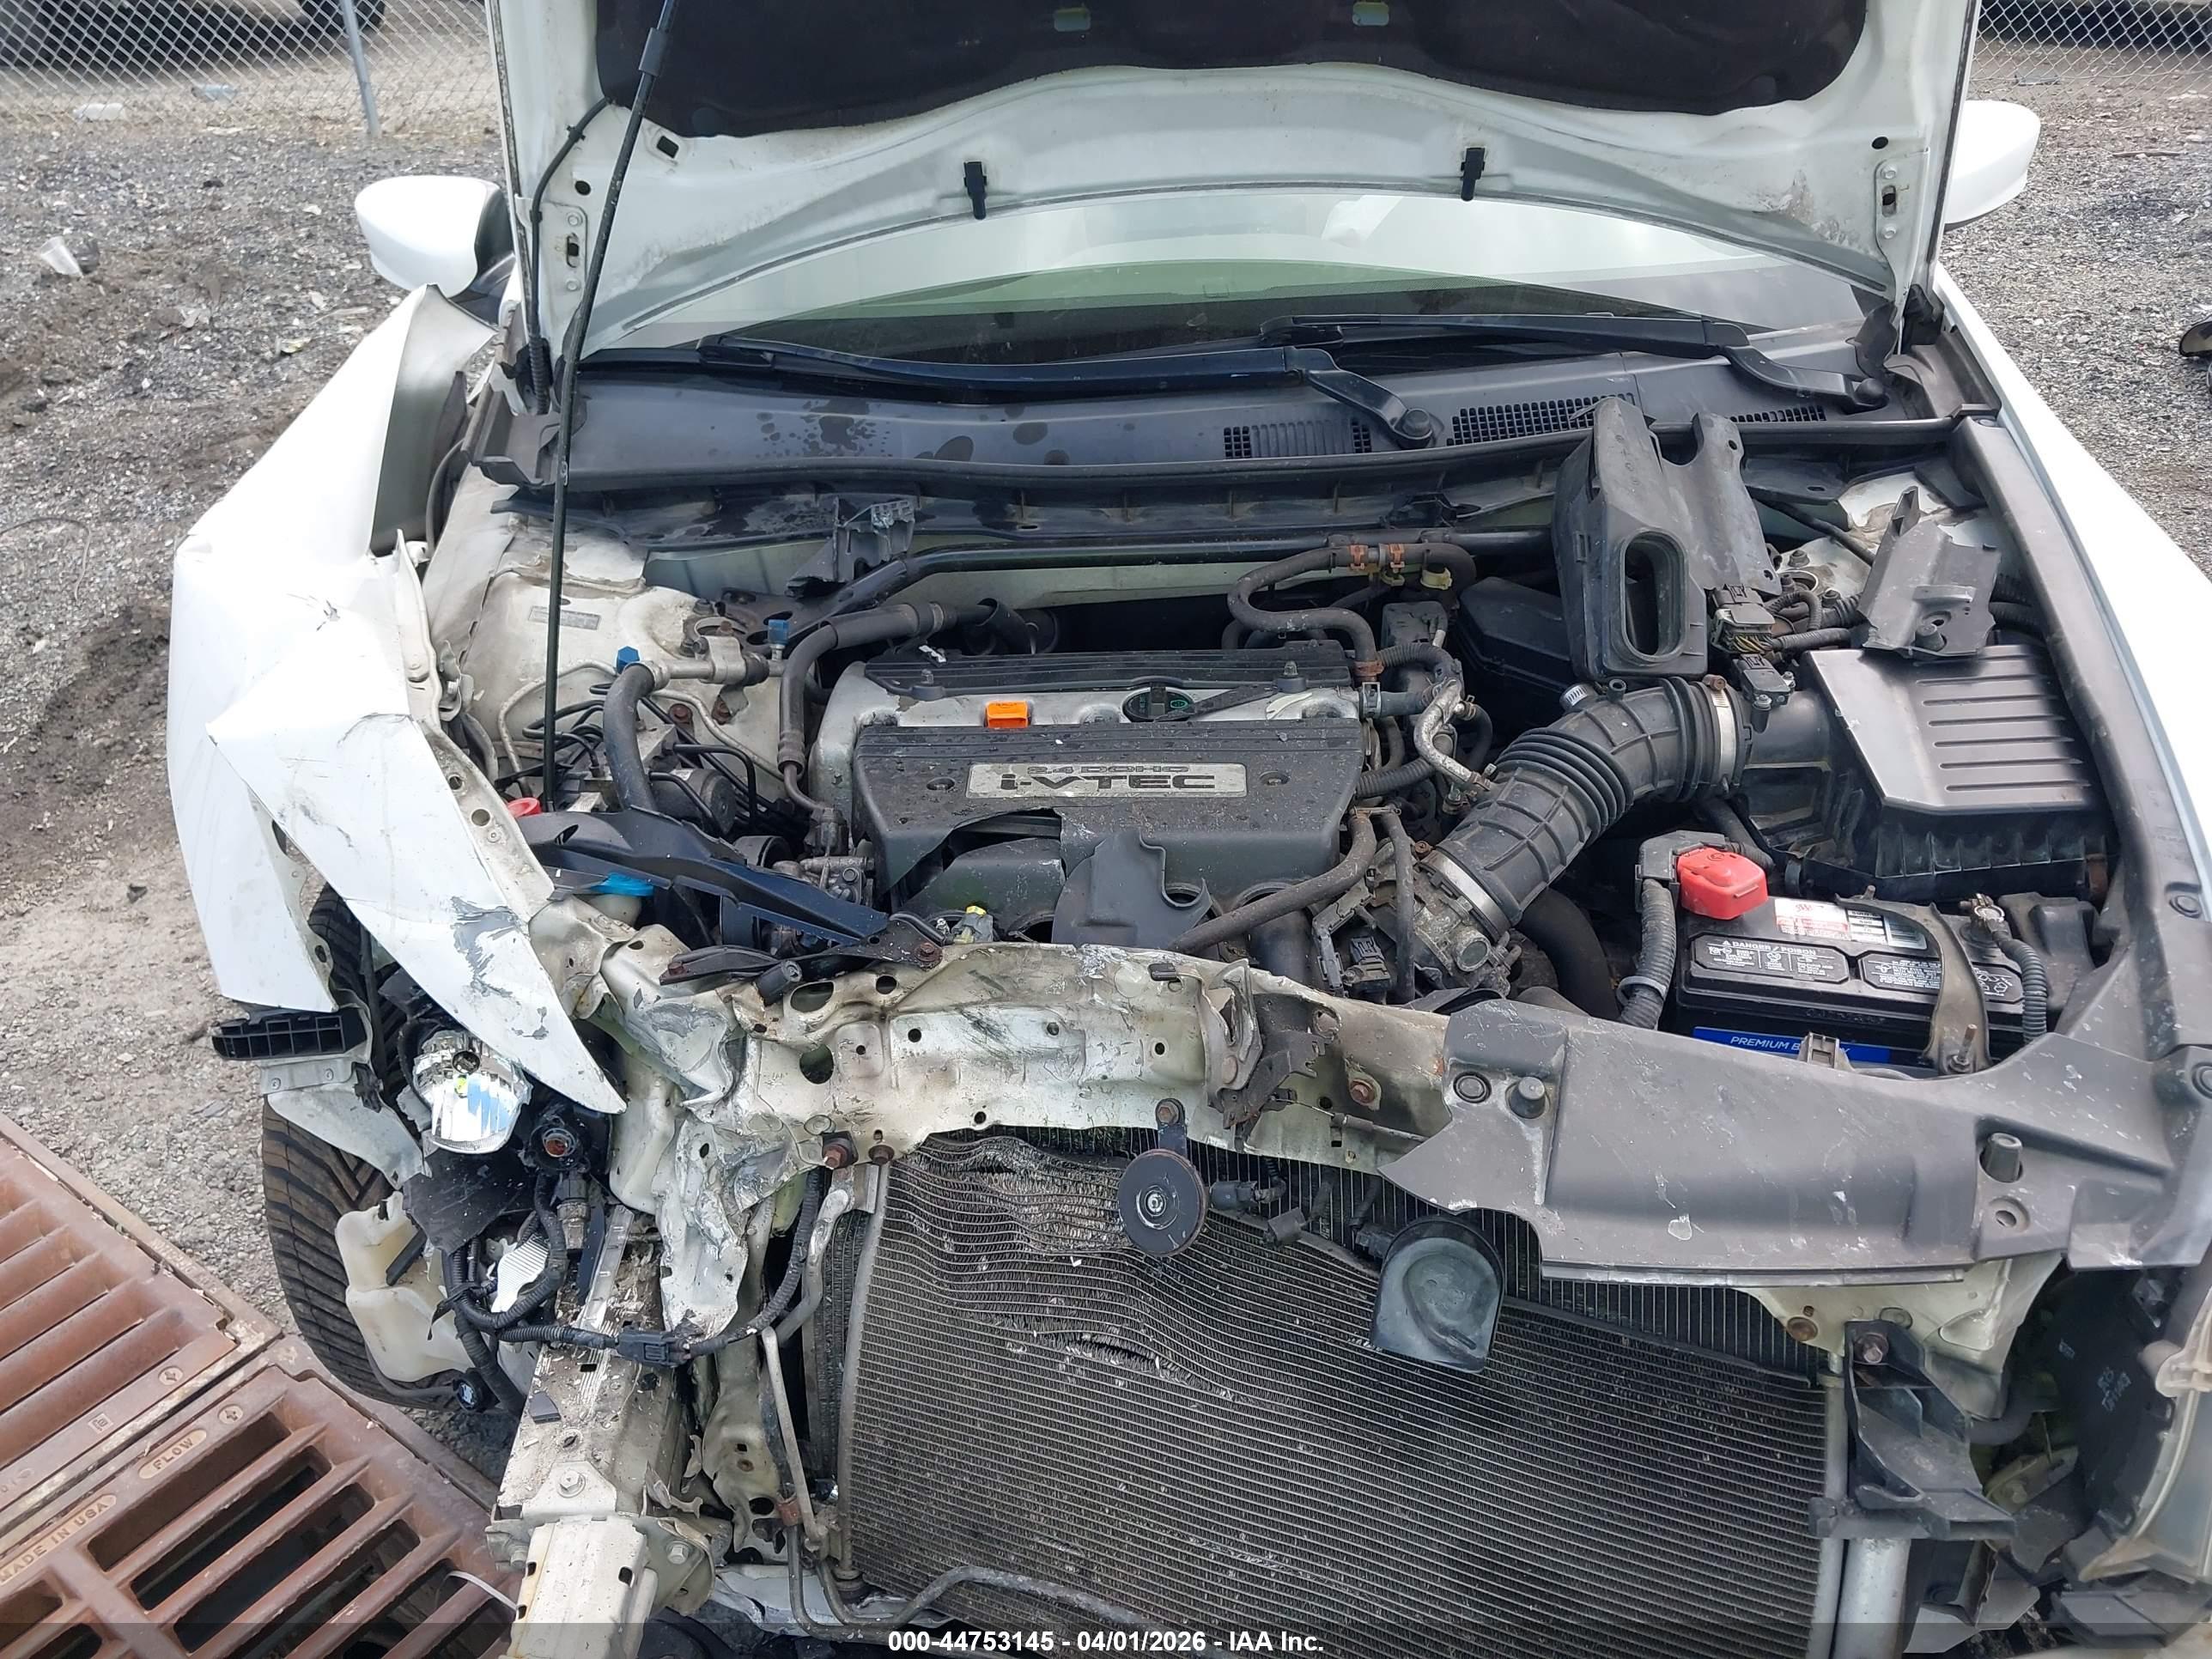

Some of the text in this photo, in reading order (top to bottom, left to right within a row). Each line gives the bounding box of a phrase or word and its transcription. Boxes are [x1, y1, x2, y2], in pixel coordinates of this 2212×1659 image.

[1027, 765, 1189, 775] 2.4 DOHC
[1000, 774, 1216, 790] i-VTEC
[1732, 941, 1771, 951] DANGER
[1781, 946, 1817, 956] POISON
[1729, 1036, 1790, 1050] PREMIUM
[152, 1437, 194, 1471] FLOW
[0, 1503, 108, 1582] MADE IN USA
